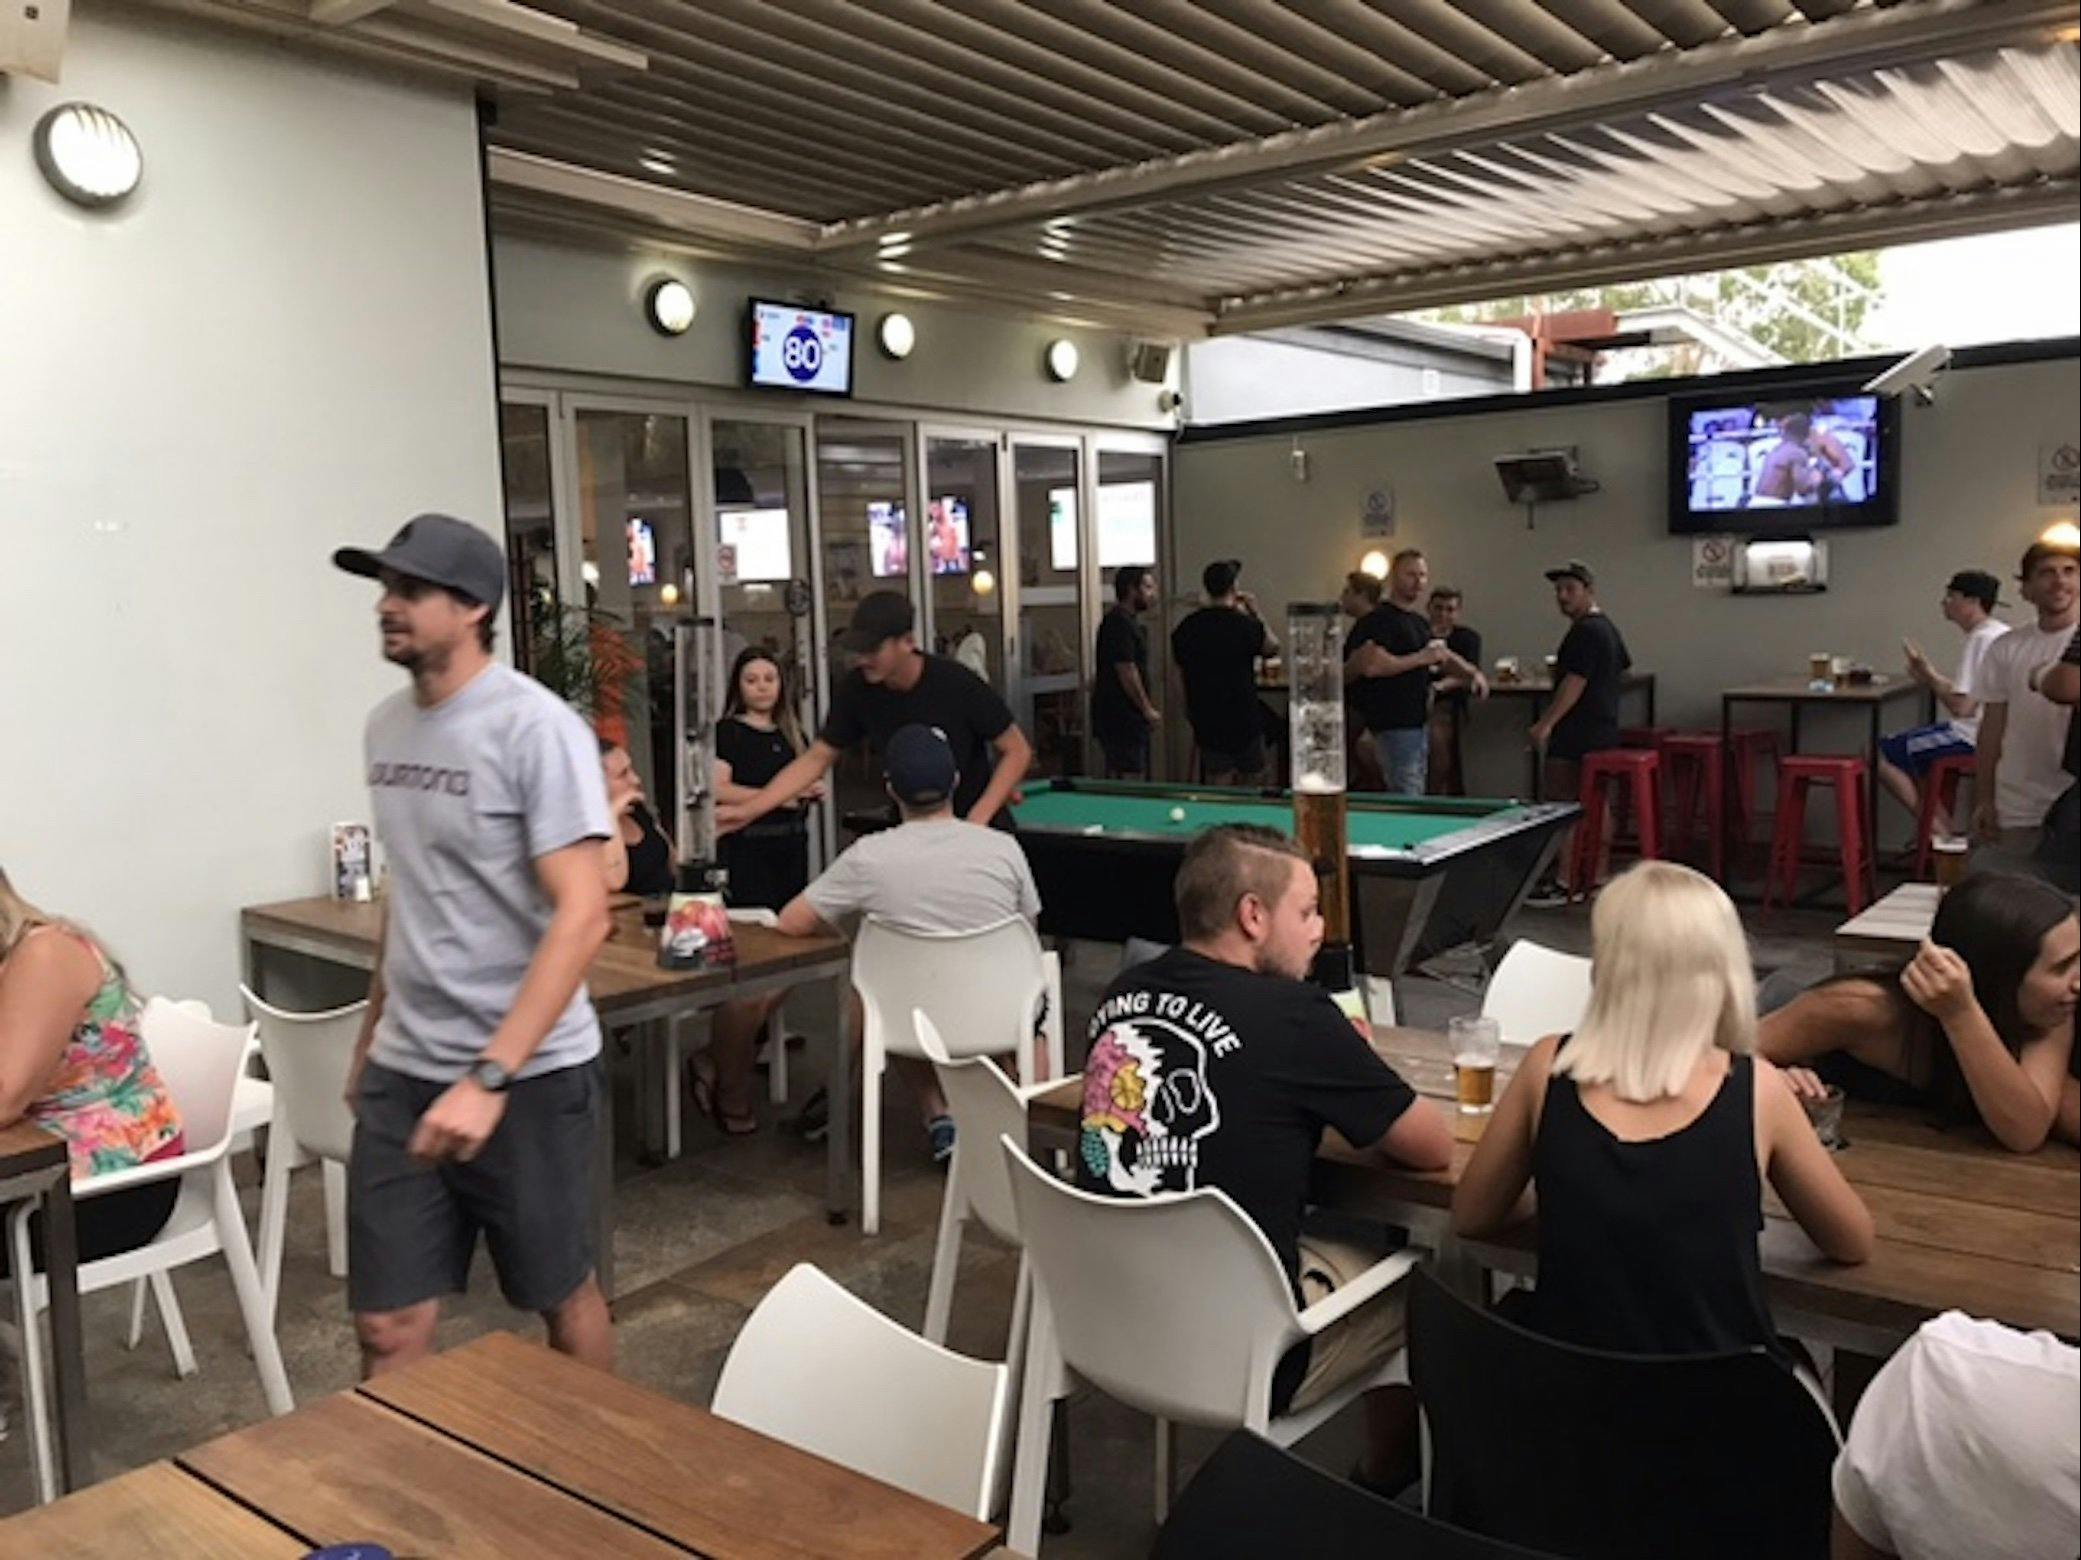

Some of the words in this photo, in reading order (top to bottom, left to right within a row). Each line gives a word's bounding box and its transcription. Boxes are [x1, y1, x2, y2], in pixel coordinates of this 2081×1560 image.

[785, 336, 821, 371] 80
[1156, 993, 1189, 1018] TO
[1185, 1002, 1243, 1058] LIVE
